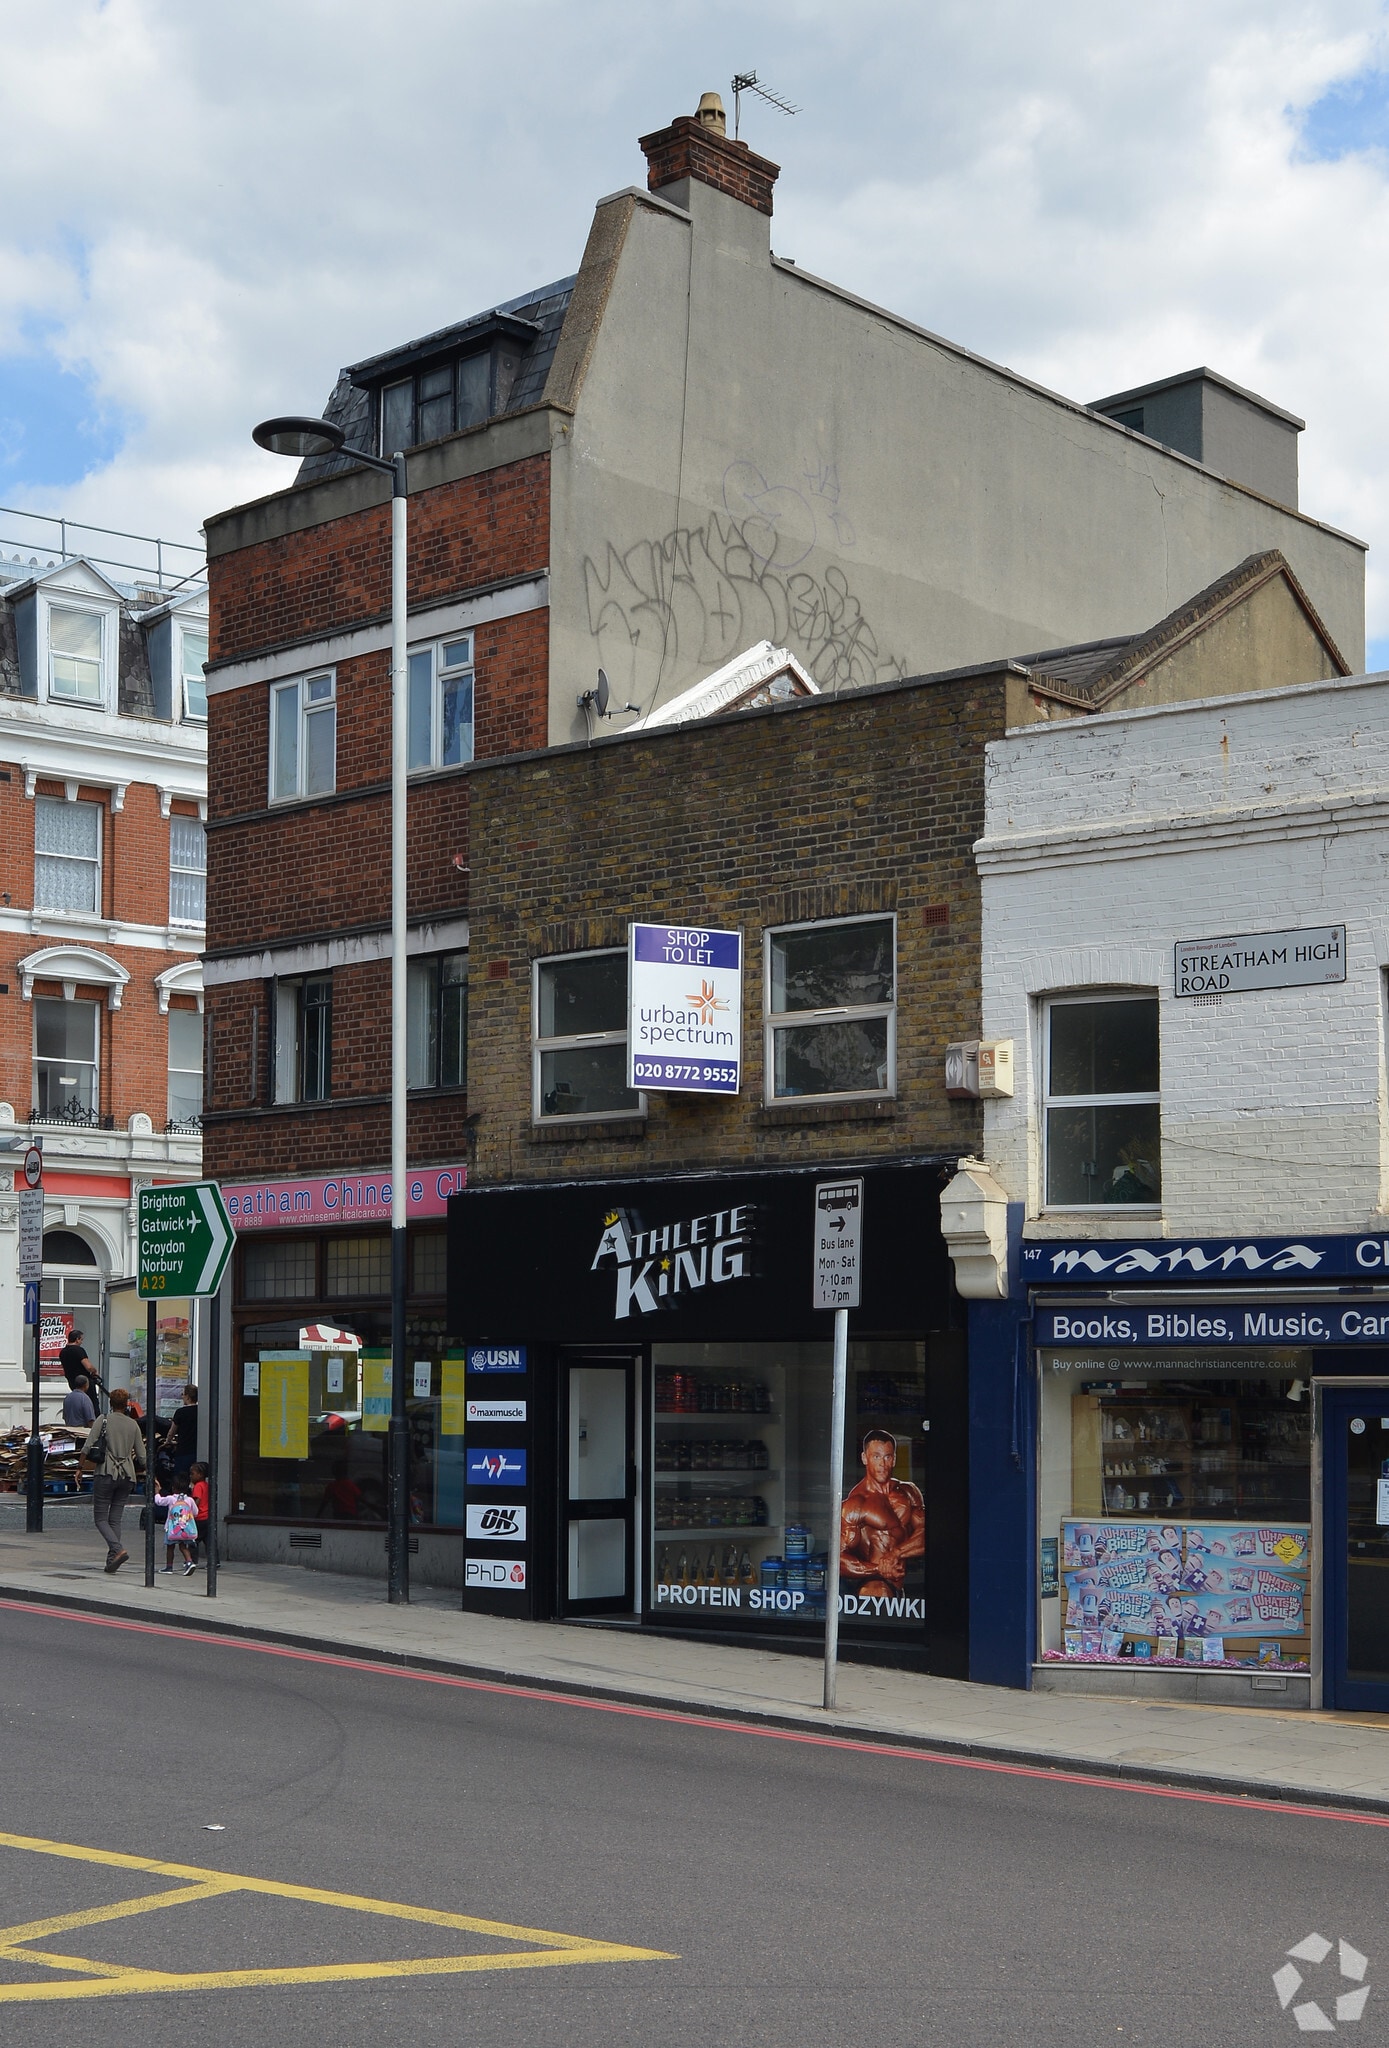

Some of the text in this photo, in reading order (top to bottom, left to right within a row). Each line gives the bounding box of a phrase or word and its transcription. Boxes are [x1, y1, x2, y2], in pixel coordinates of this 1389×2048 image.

[668, 931, 709, 947] SHOP
[663, 947, 714, 965] TO LET
[1181, 943, 1340, 974] STREATHAM HIGH
[1181, 974, 1230, 993] ROAD
[640, 1005, 699, 1026] urban
[640, 1026, 733, 1046] spectrum
[636, 1063, 737, 1083] 020 8772 9552
[142, 1194, 186, 1212] Brighton
[224, 1187, 312, 1216] eatham
[323, 1180, 424, 1209] Chinee
[142, 1216, 184, 1232] Gatwick
[591, 1205, 748, 1270] ATHLETE
[821, 1237, 854, 1250] Bus lane
[142, 1240, 185, 1257] Croydon
[142, 1258, 183, 1273] Norbury
[1024, 1249, 1041, 1260] 147
[1050, 1245, 1326, 1274] manna
[42, 1327, 64, 1337] RUSH
[1053, 1316, 1138, 1342] Books,
[1148, 1314, 1233, 1340] Bibles,
[1245, 1313, 1331, 1340] Music,
[487, 1350, 520, 1366] USN
[1053, 1358, 1297, 1371] Buy online @ www.mannachristiancentre.co.uk
[481, 1509, 517, 1530] ON
[467, 1564, 506, 1582] PhD
[657, 1584, 741, 1607] PROTEIN
[749, 1589, 805, 1611] SHOP
